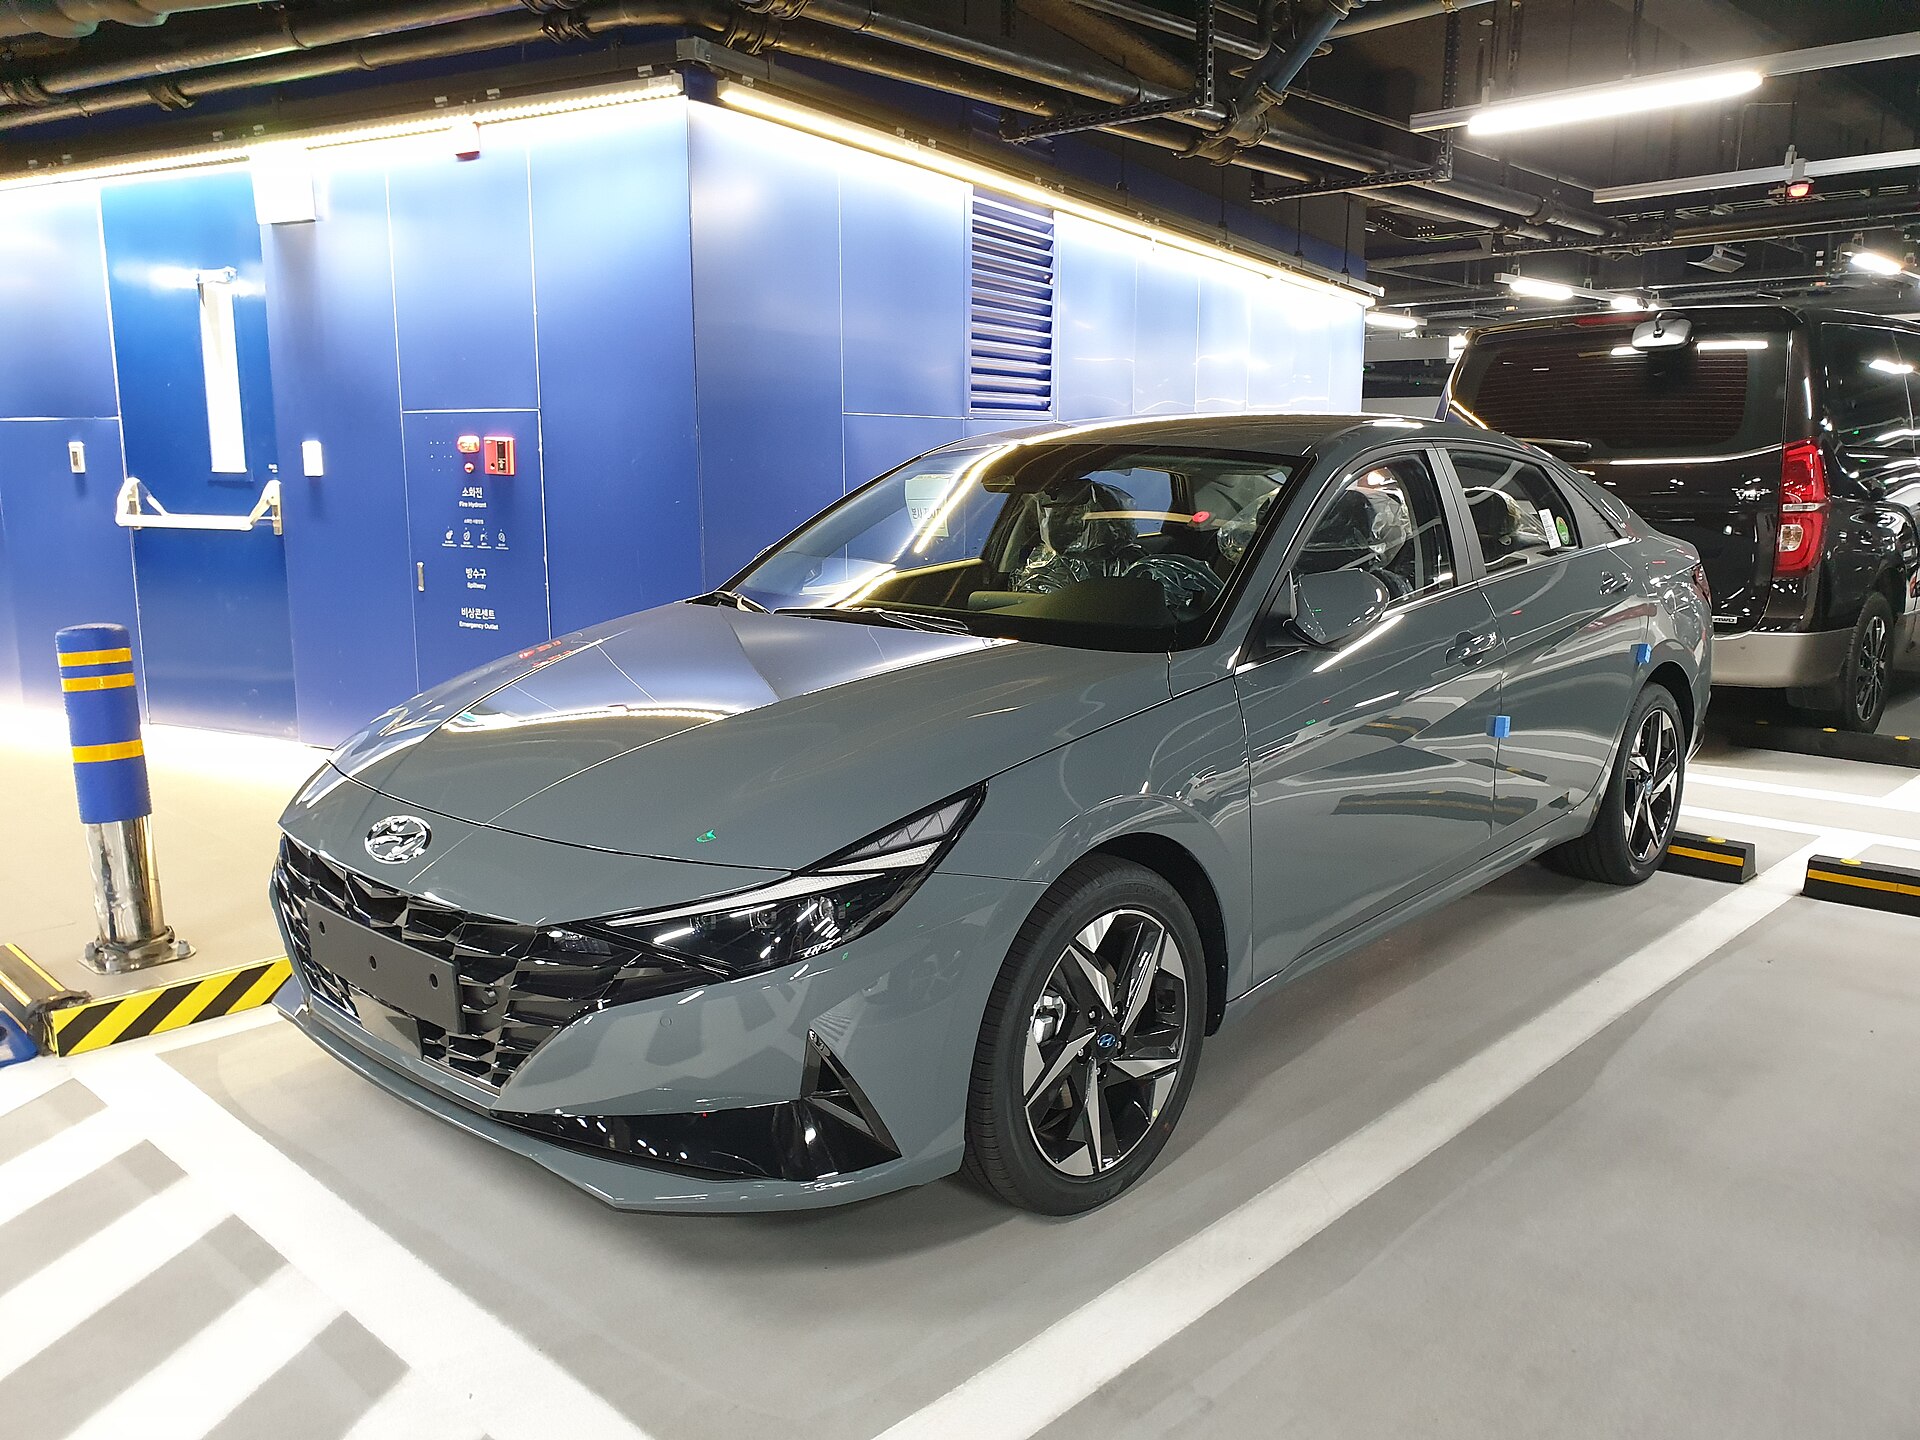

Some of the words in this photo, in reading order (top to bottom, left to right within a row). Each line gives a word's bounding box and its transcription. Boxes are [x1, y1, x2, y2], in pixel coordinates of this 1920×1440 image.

[462, 486, 483, 499] 소화전
[459, 500, 468, 508] Fire
[466, 568, 487, 580] 방수구
[461, 607, 496, 620] 비상콘센트
[459, 620, 484, 630] Emergency
[484, 622, 499, 631] Outlet
